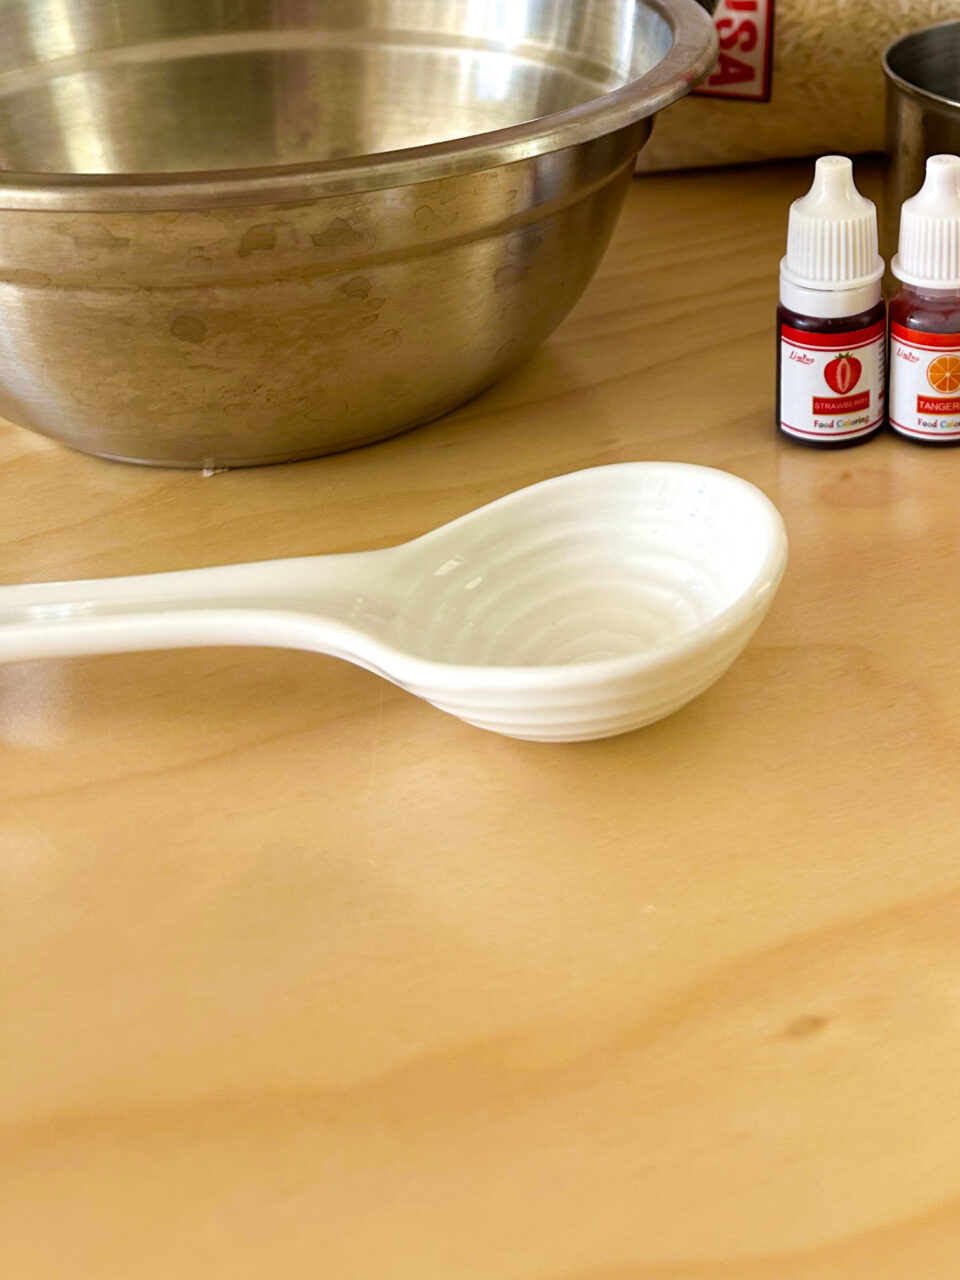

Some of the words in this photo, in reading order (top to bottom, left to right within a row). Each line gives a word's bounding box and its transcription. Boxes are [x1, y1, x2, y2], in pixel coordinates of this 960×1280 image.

[813, 419, 834, 429] Food
[836, 415, 870, 428] Coloring
[917, 418, 938, 428] Food
